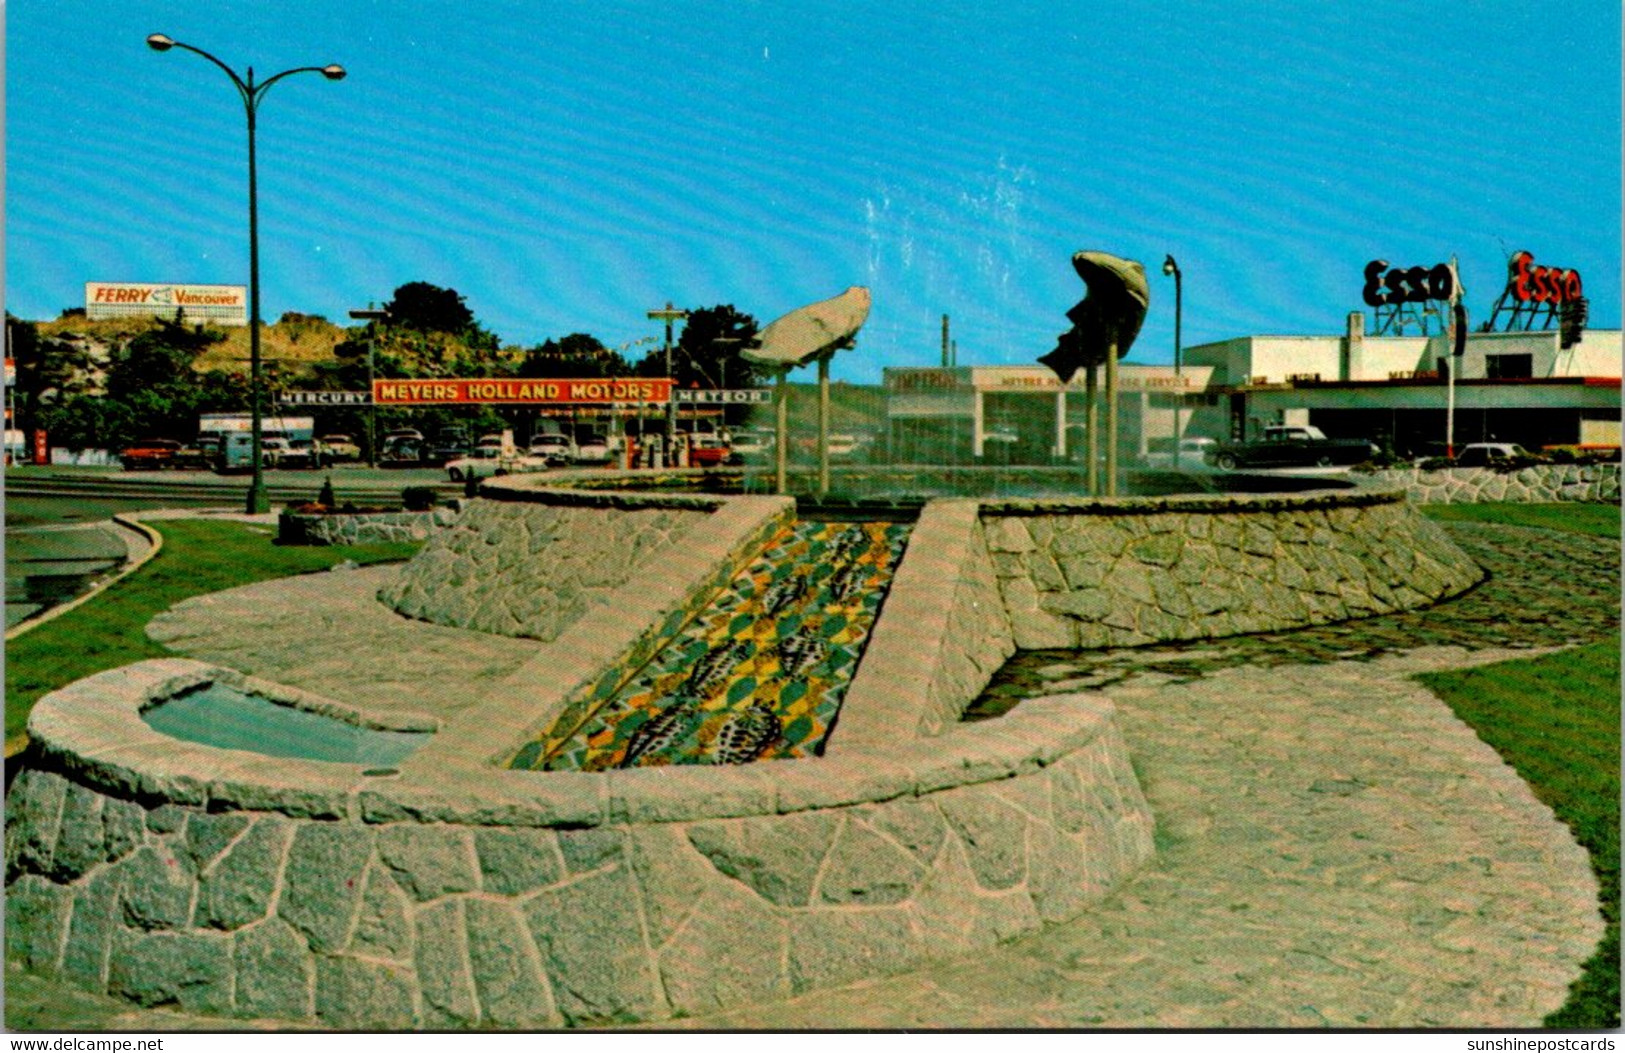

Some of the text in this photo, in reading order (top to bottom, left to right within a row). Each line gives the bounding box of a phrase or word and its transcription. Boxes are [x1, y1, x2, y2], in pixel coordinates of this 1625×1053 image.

[1363, 260, 1454, 307] Esso
[1510, 251, 1582, 304] Esso
[95, 287, 240, 305] FERRY Vancouver
[280, 392, 367, 403] MERCURY
[381, 384, 458, 400] MEYERS
[468, 383, 560, 399] HOLLAND
[679, 391, 763, 402] METEOR
